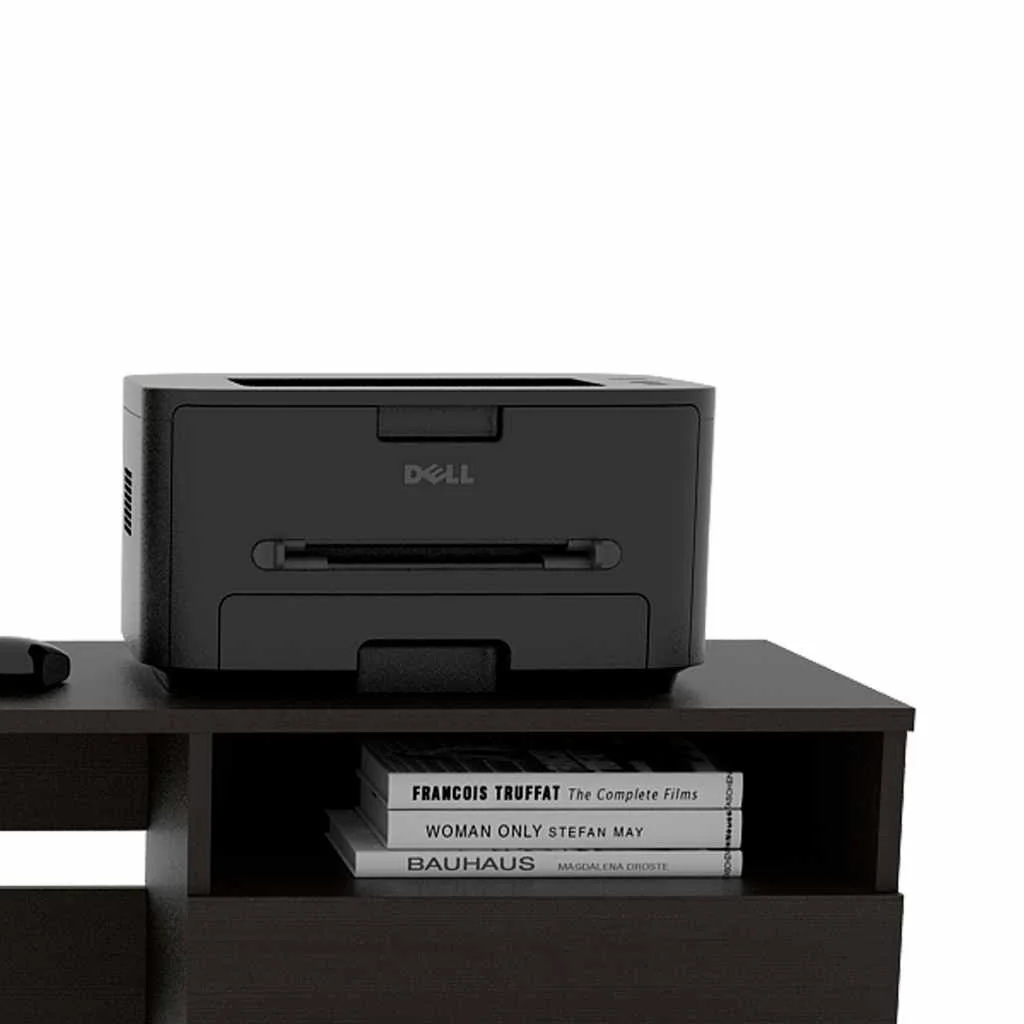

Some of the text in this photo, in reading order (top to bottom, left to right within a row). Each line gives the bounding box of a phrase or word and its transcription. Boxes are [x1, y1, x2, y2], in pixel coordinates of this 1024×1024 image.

[404, 463, 475, 485] DELL
[412, 784, 699, 803] FRANCOIS TRUFFAT The Complete Films
[426, 823, 645, 839] WOMAN ONLY STEFAN MAY
[407, 855, 669, 872] BAUHAUS MAGDALENA DROSTE
